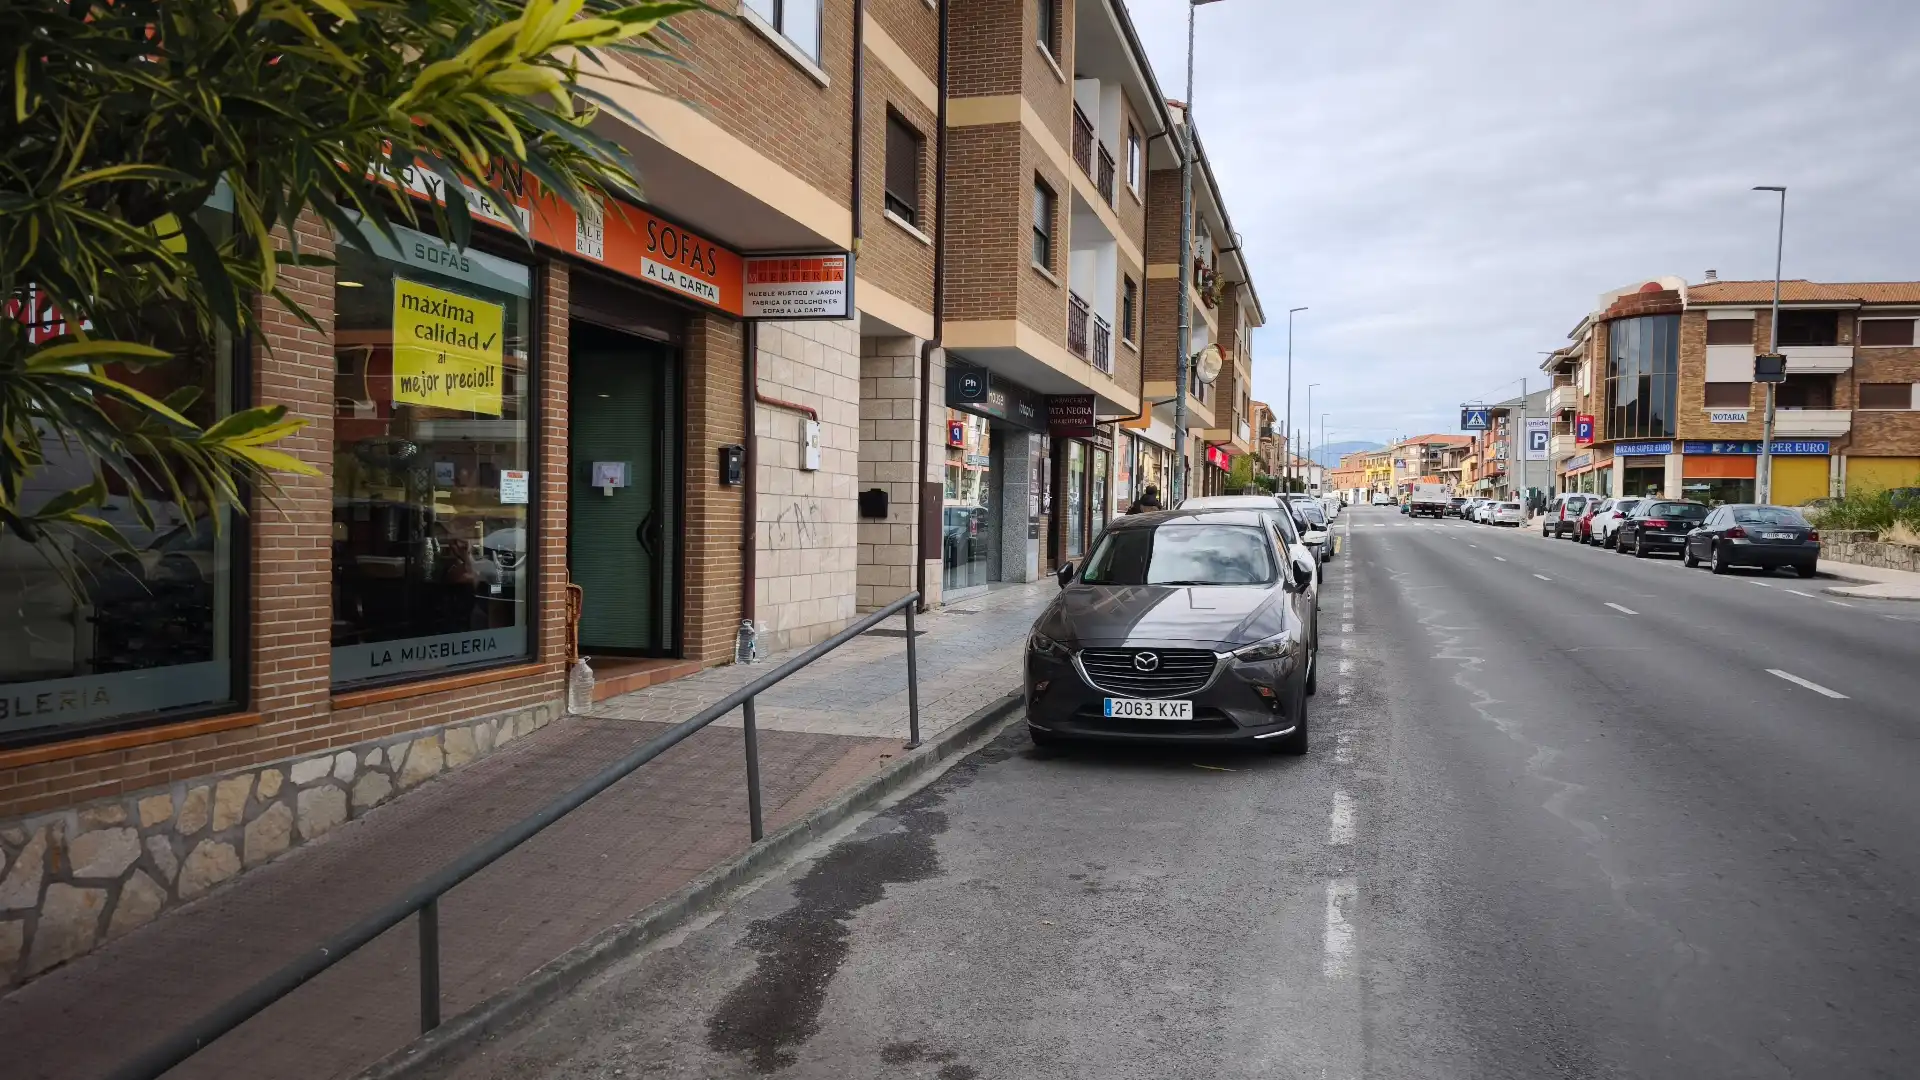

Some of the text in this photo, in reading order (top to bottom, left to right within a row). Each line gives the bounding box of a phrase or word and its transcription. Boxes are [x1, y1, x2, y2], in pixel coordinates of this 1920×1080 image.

[647, 219, 716, 278] SOFAS
[415, 243, 470, 273] SOFAS
[647, 263, 715, 300] A LA CARTA
[414, 323, 479, 351] calidad
[400, 366, 495, 397] mejor precio!!
[965, 379, 976, 387] Ph
[1066, 406, 1092, 415] NEGRA
[1712, 413, 1745, 421] NOTARIA
[1580, 423, 1589, 437] P
[1533, 432, 1547, 449] P
[1615, 443, 1670, 454] BAZAR SUPER EURO
[1756, 443, 1825, 453] SPER EURO
[370, 636, 497, 667] LA MUEBLERIA
[1114, 701, 1153, 716] 2063
[1159, 703, 1189, 717] KXF
